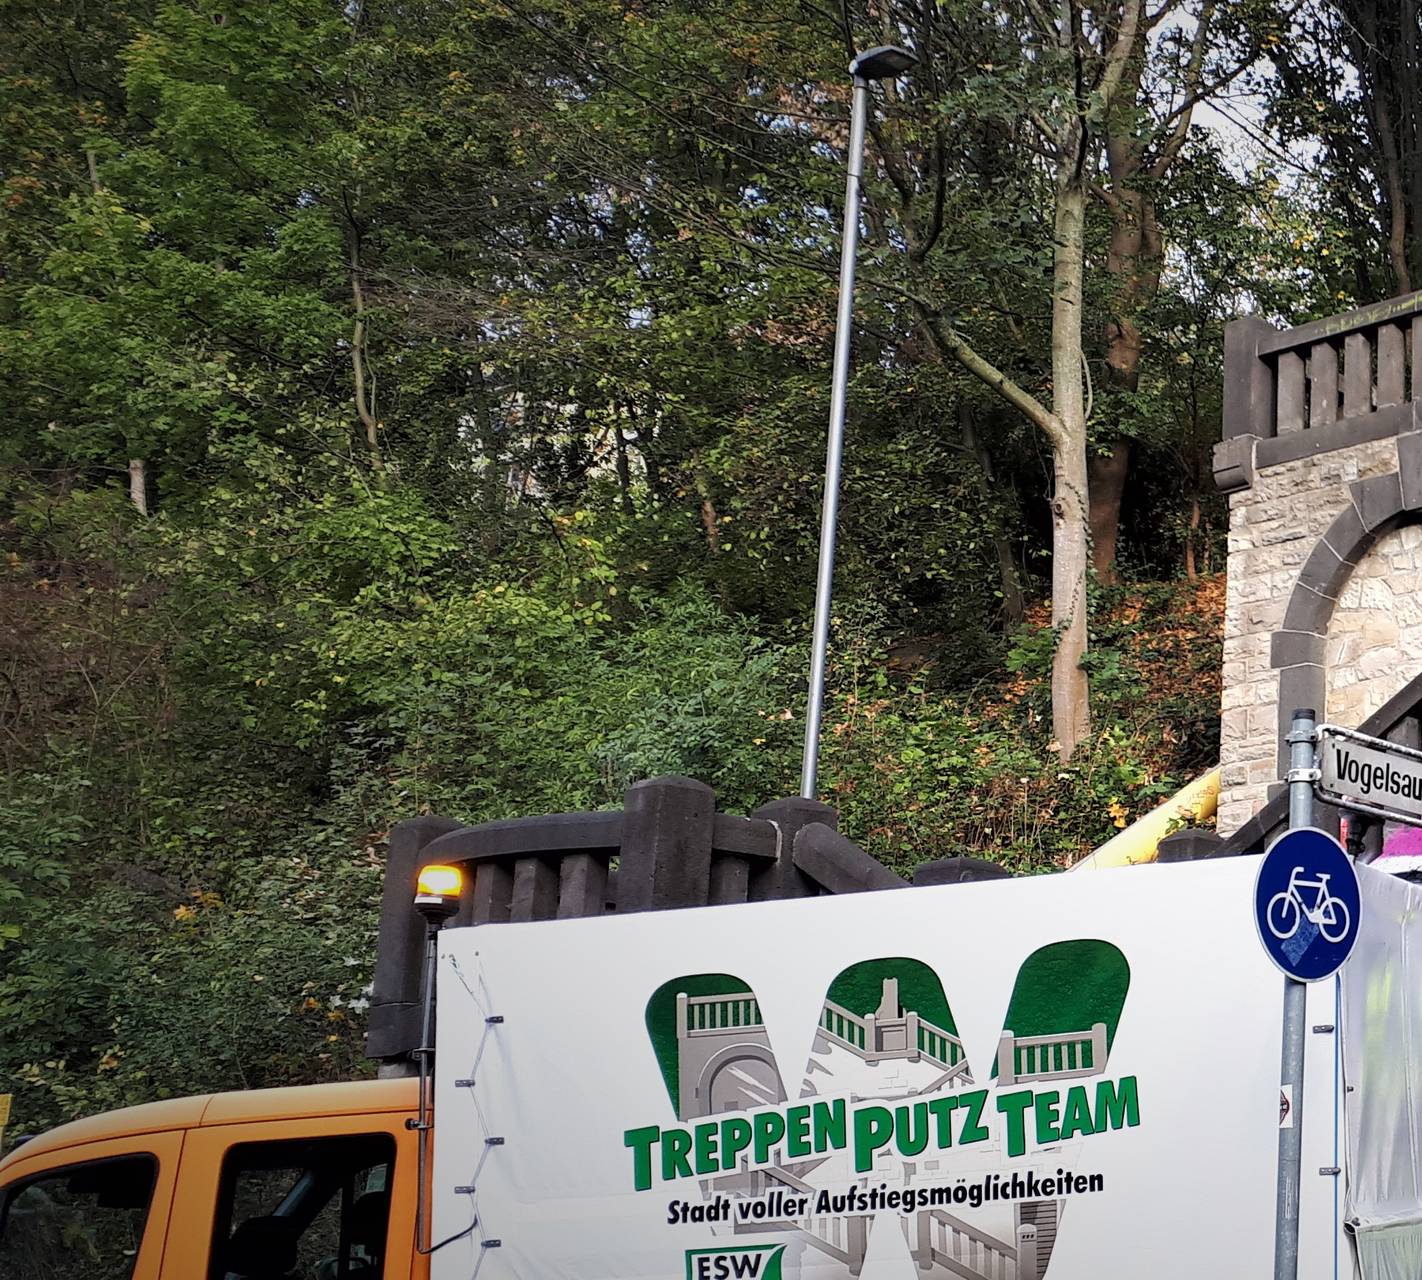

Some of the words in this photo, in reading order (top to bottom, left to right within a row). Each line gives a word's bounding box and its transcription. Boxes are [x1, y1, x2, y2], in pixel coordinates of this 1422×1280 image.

[623, 1097, 847, 1192] TREPPEN
[852, 1088, 990, 1174] PUTZ
[996, 1074, 1141, 1158] TEAM
[666, 1194, 732, 1225] Stadt
[738, 1190, 809, 1220] voller
[814, 1167, 1105, 1214] Aufstiegsmöglichkeiten
[697, 1253, 762, 1280] ESW
